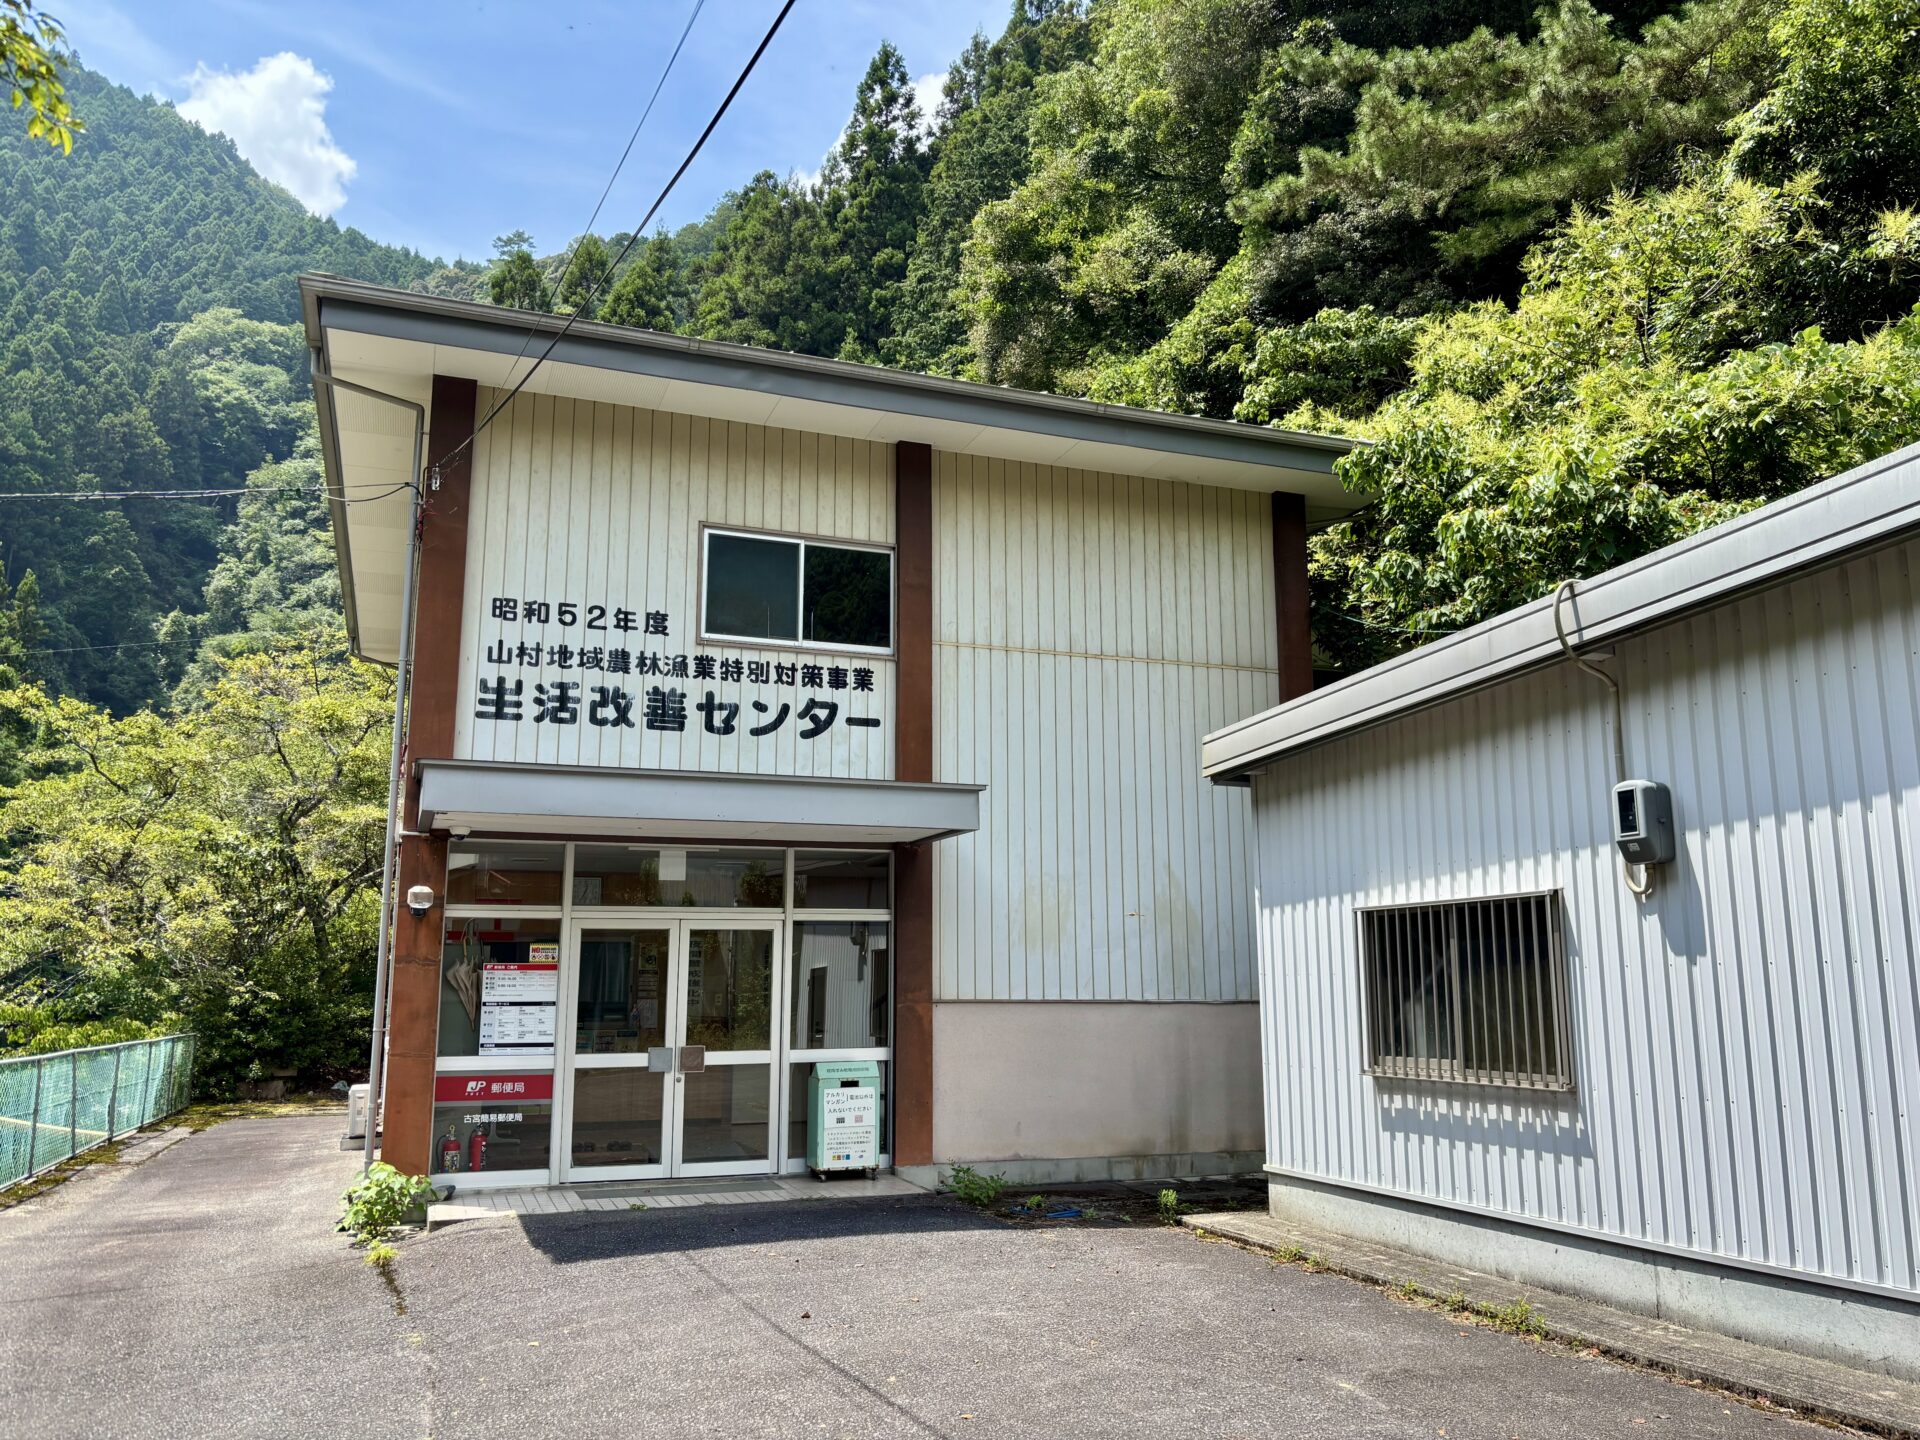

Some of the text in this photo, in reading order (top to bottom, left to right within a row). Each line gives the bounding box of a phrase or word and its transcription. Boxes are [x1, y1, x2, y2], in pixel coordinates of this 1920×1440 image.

[491, 597, 670, 636] 昭和52年度
[487, 639, 876, 692] 山村地域農林漁業特別対策事業
[475, 676, 882, 740] 生活改善センター
[491, 1082, 525, 1093] 郵便局
[464, 1113, 522, 1123] 古宮簡易郵便局
